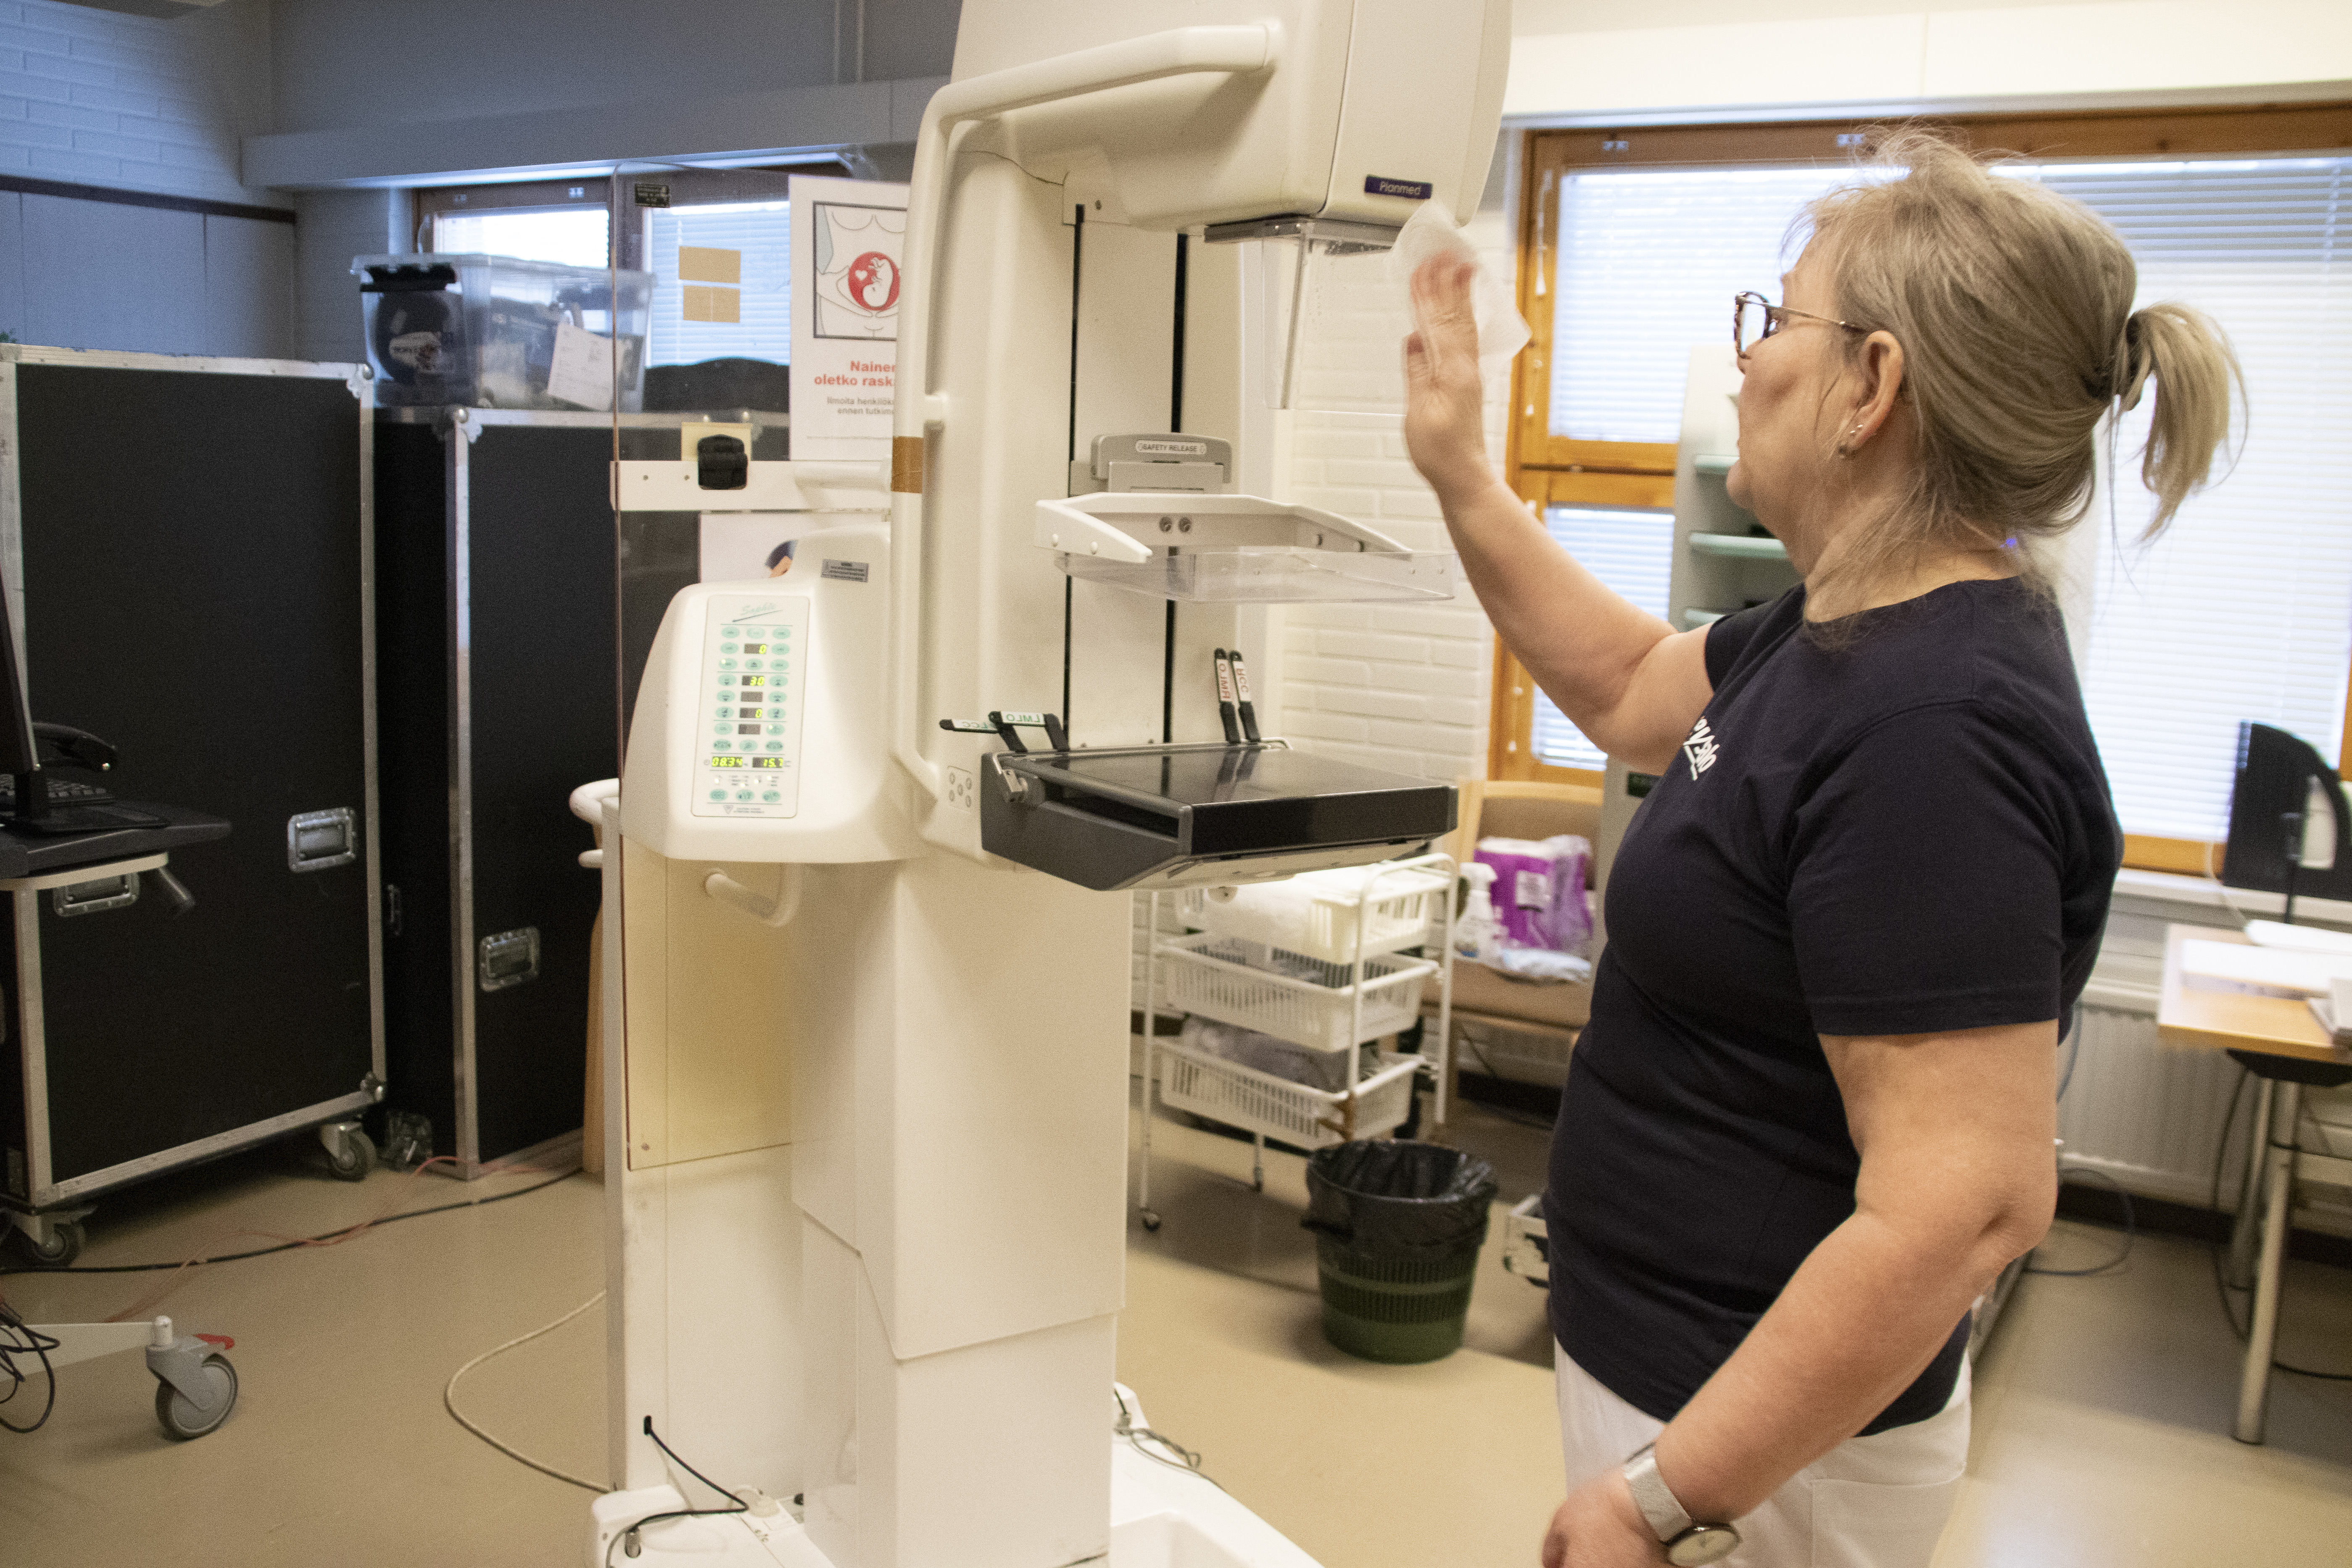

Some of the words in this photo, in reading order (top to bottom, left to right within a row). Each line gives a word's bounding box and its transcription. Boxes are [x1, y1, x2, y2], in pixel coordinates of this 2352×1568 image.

[1379, 181, 1421, 196] Planmed
[815, 374, 858, 386] oletko
[862, 376, 895, 386] rask
[759, 644, 766, 654] 0
[750, 676, 765, 686] 30
[755, 709, 762, 718] 0
